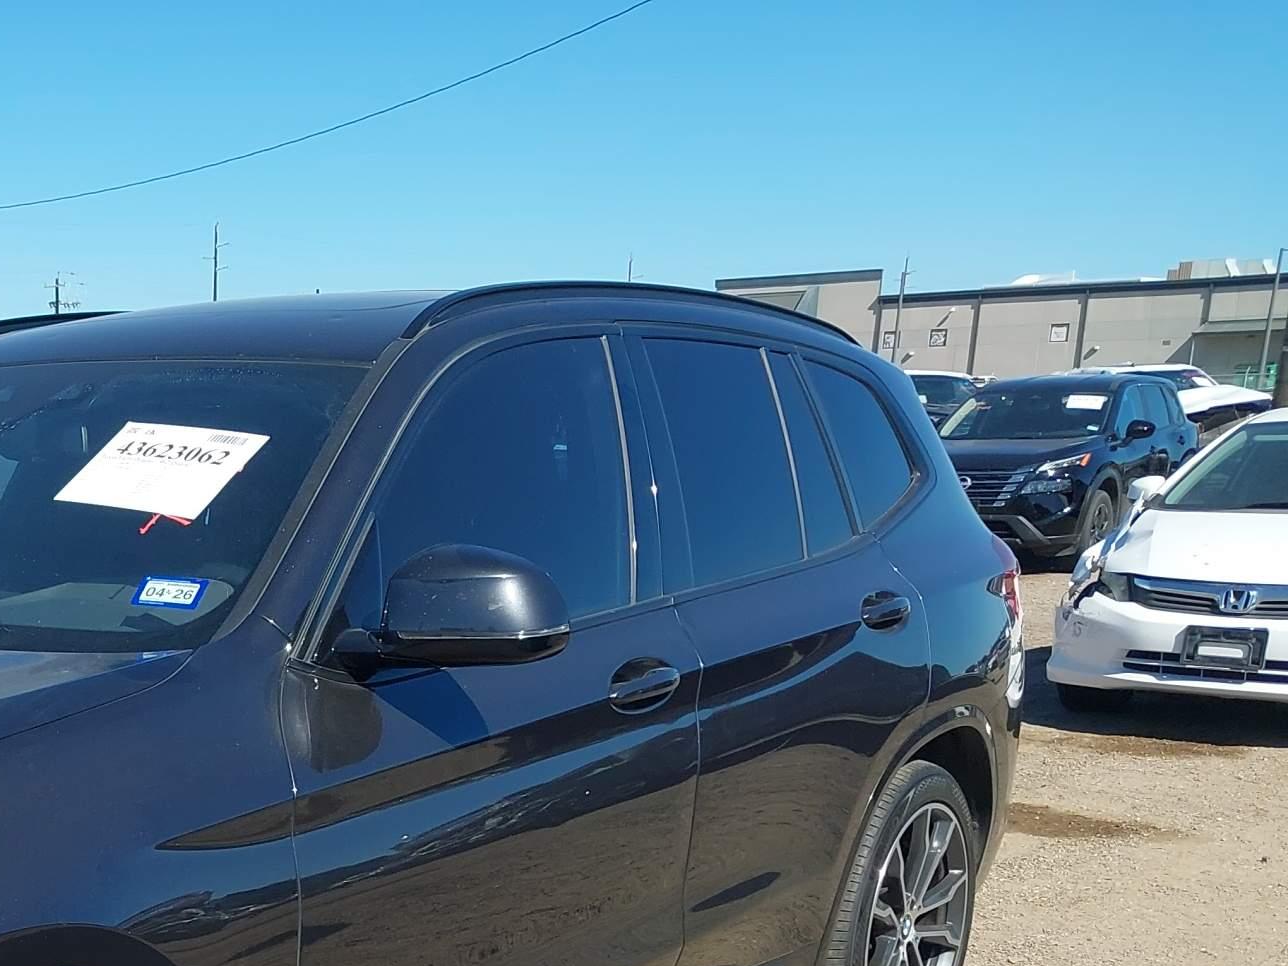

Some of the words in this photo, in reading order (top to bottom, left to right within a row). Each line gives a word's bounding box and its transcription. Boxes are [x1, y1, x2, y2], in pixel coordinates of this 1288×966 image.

[117, 440, 231, 465] 43623062
[145, 586, 166, 597] 04
[172, 588, 194, 600] 26
